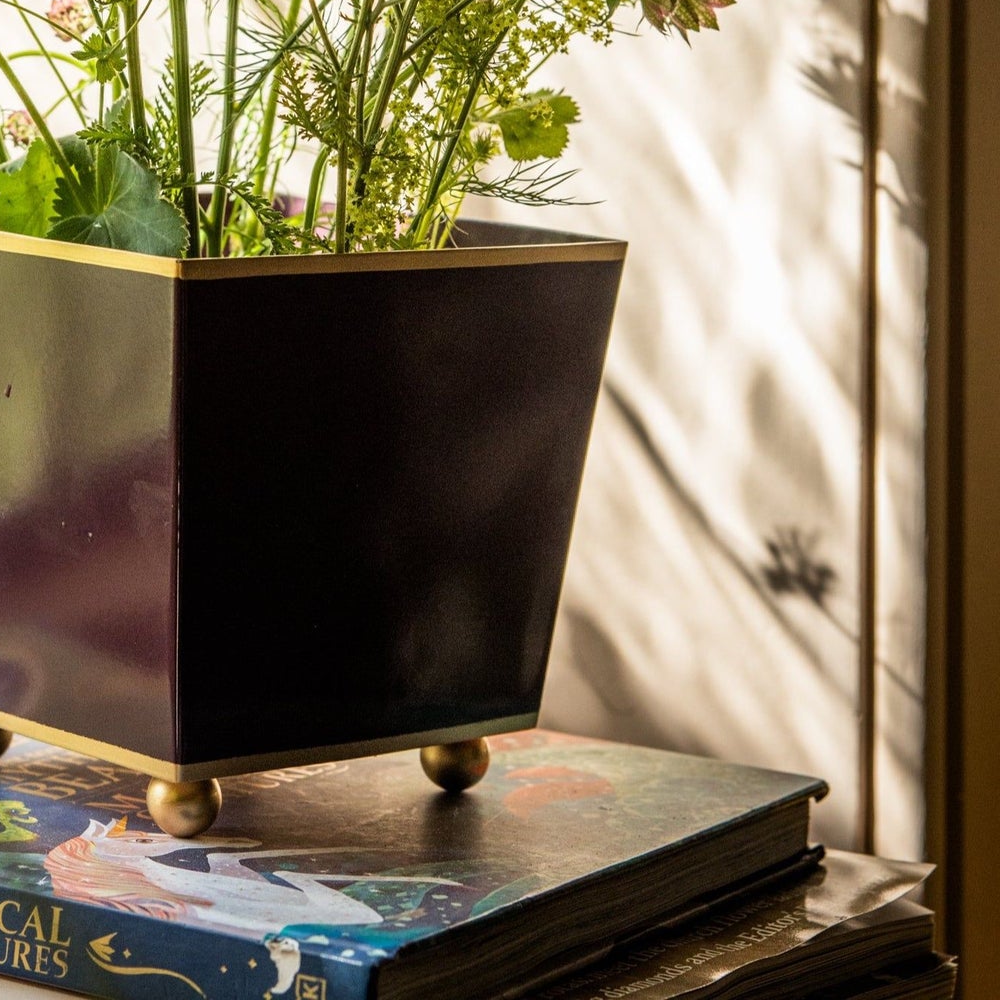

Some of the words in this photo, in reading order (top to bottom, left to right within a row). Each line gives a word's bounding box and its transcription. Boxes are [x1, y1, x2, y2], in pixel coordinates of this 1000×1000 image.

[600, 963, 693, 998] diamonds
[685, 945, 721, 966] and
[711, 936, 753, 957] the
